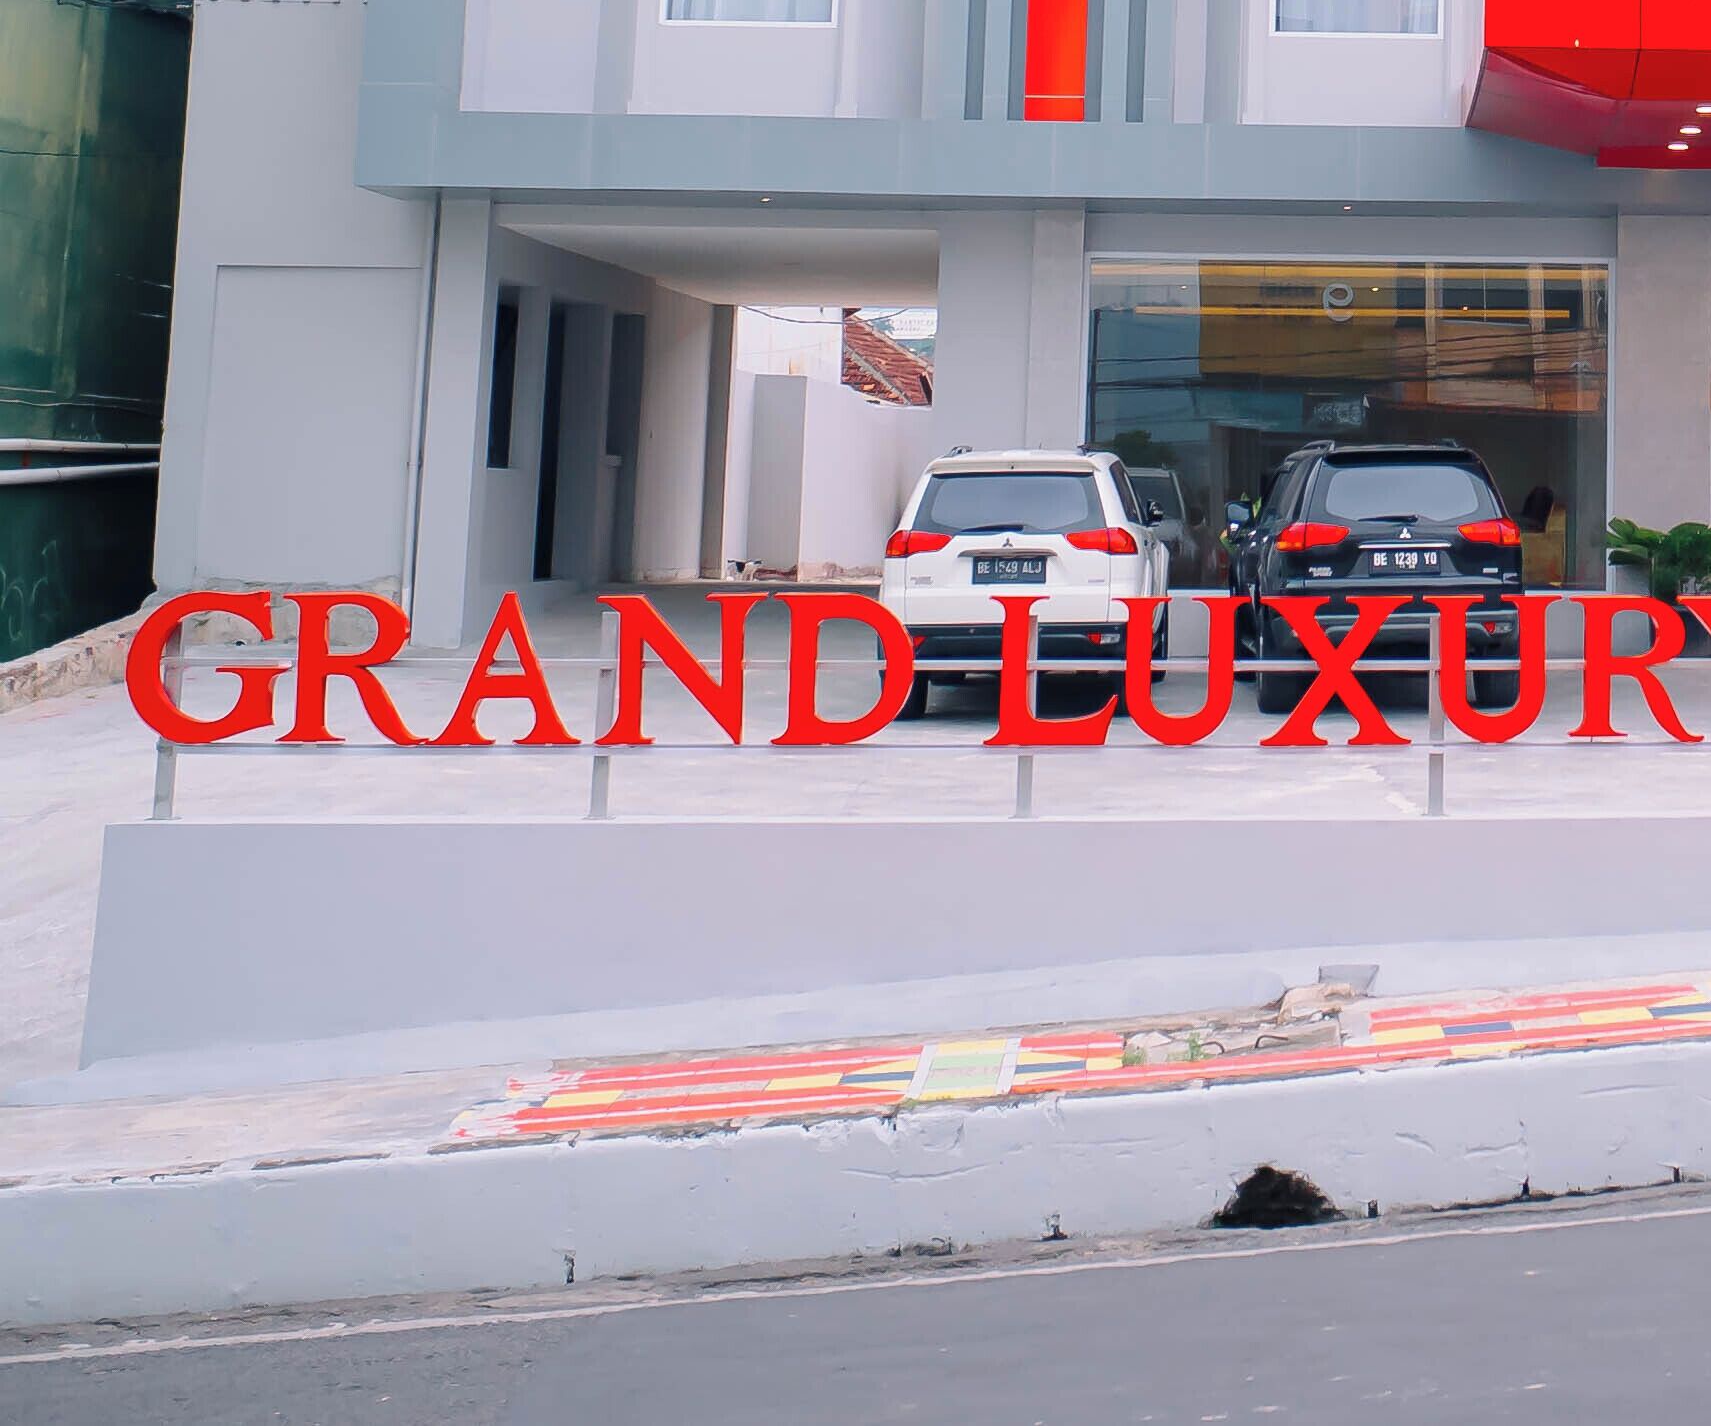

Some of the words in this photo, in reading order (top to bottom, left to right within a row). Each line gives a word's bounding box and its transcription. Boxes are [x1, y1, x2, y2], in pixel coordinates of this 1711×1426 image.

[1373, 552, 1388, 566] BE
[1394, 551, 1418, 565] 1239
[126, 590, 915, 746] GRAND
